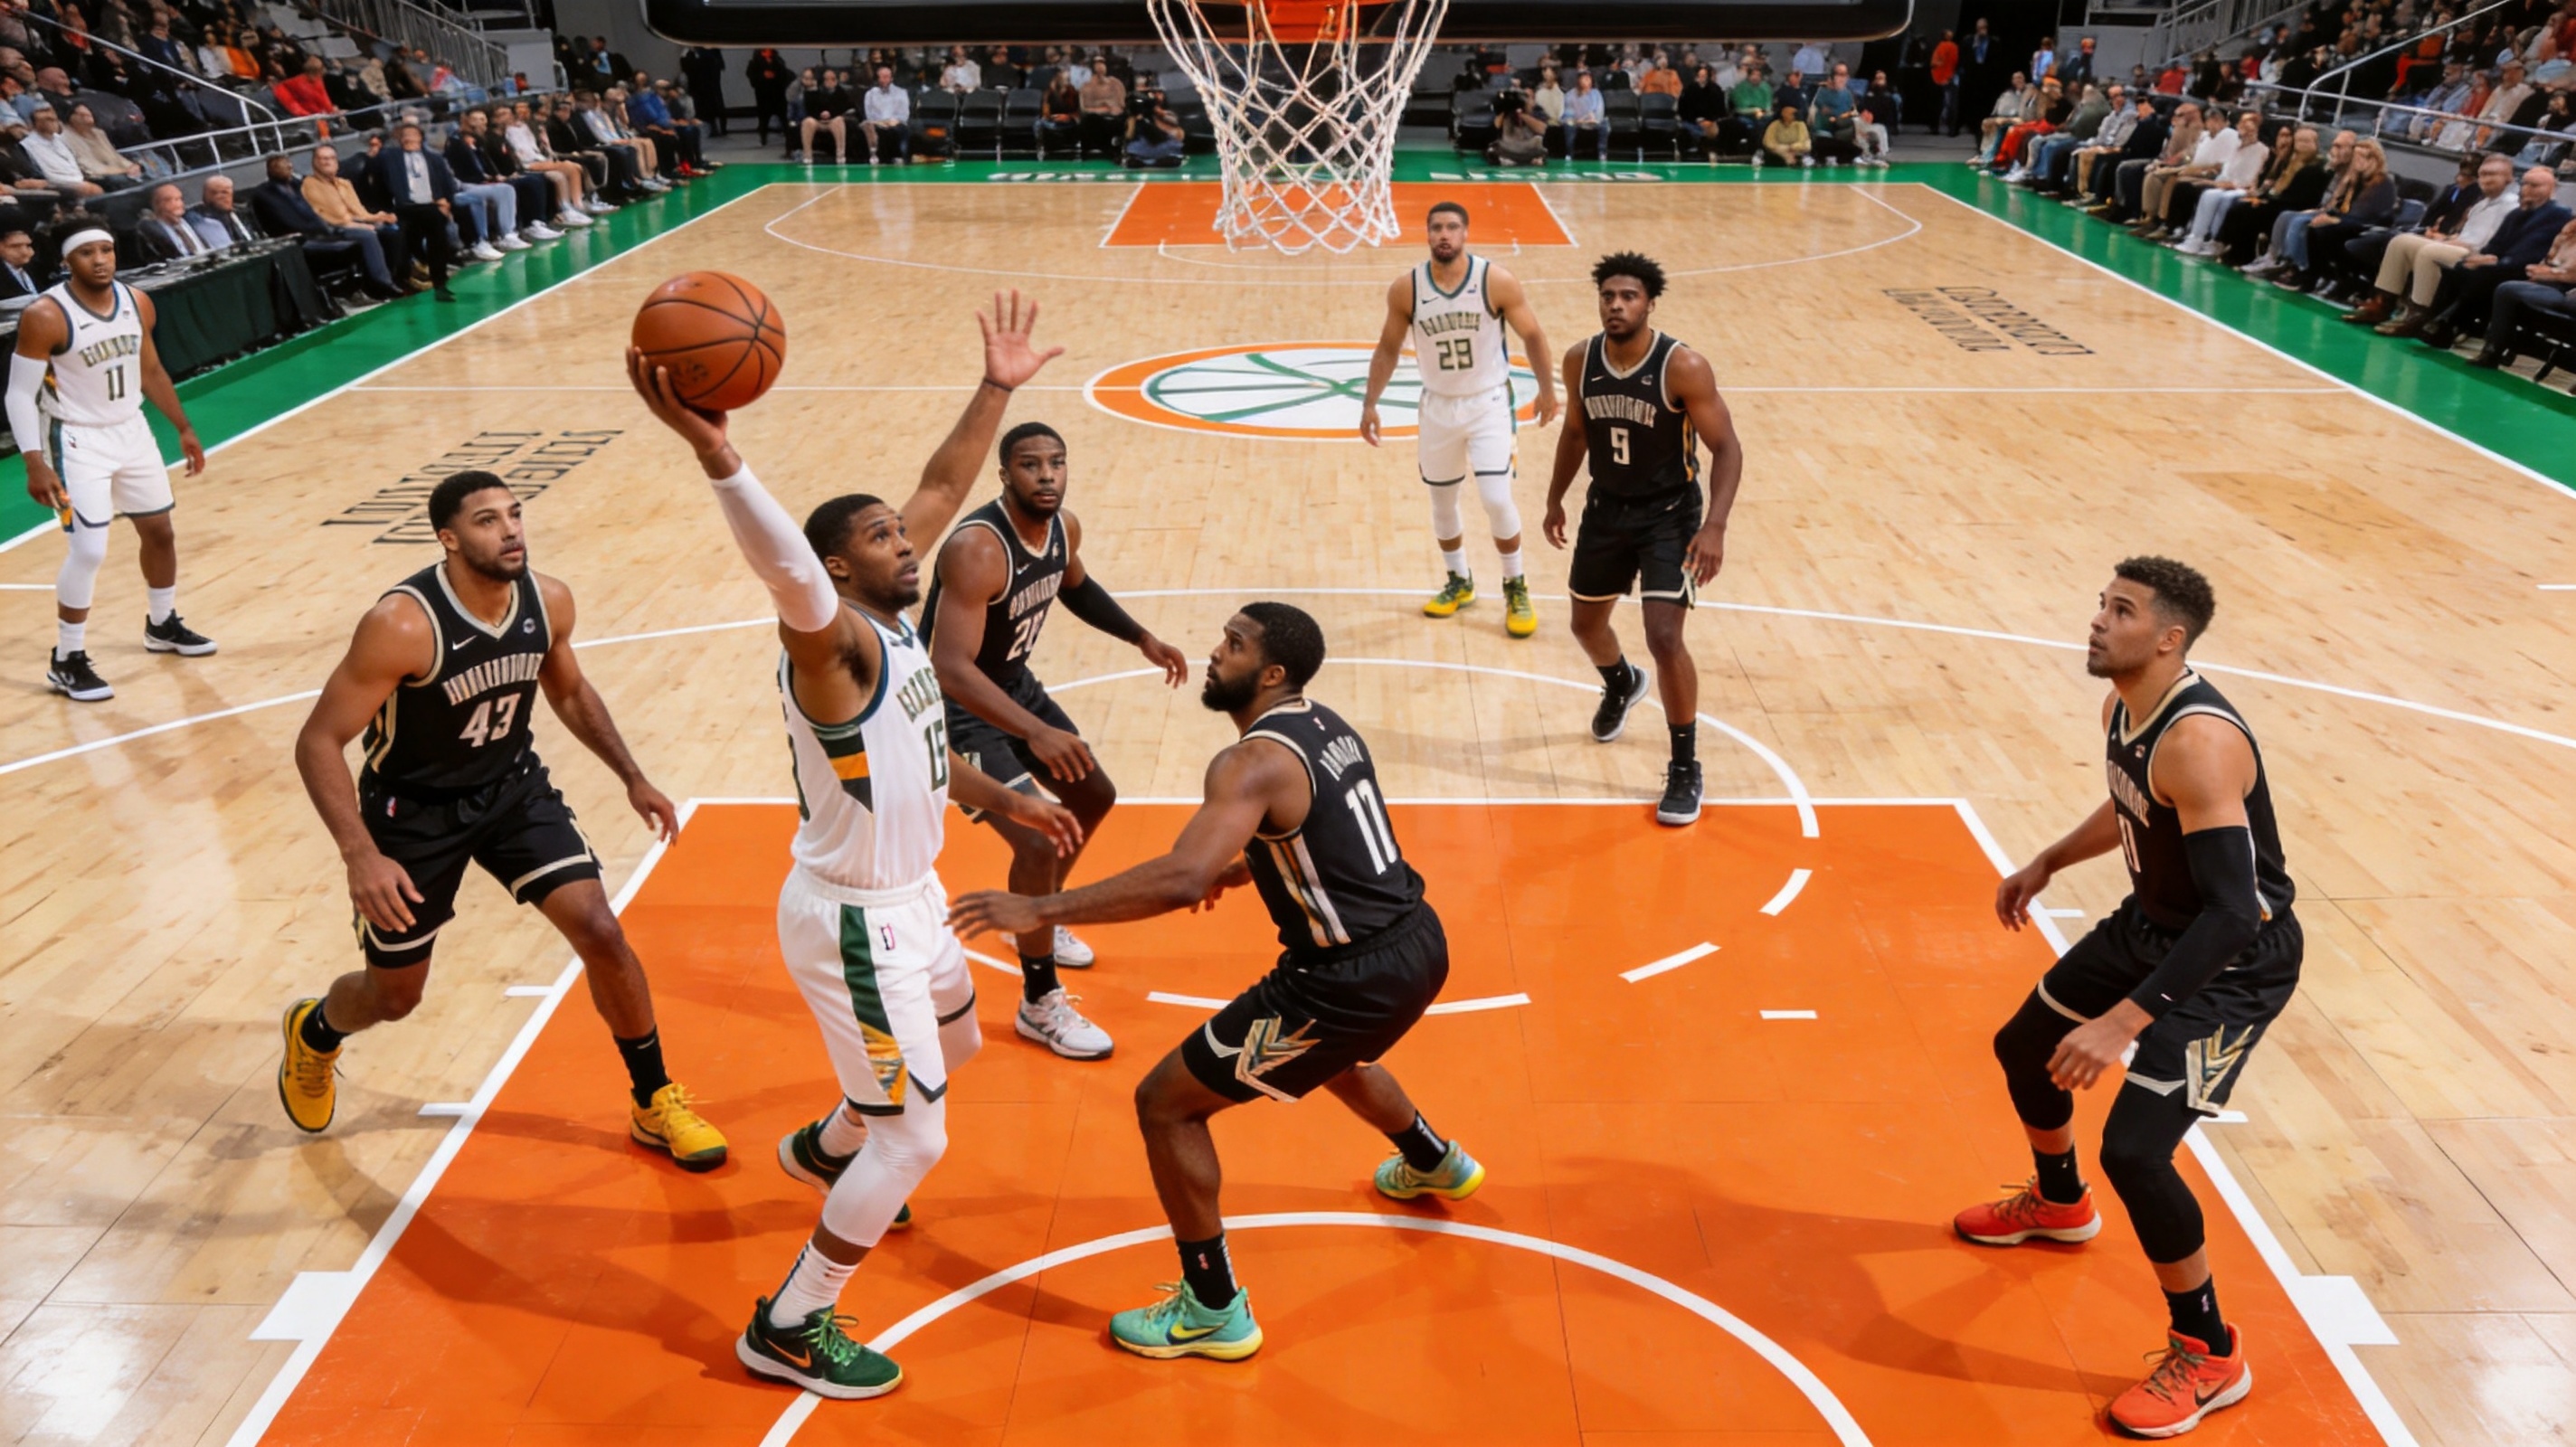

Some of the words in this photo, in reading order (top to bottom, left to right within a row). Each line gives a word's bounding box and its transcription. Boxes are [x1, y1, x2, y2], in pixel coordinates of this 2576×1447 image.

[105, 364, 125, 402] 11
[1610, 427, 1630, 465] 9
[459, 692, 522, 748] 43
[1344, 779, 1398, 875] 11
